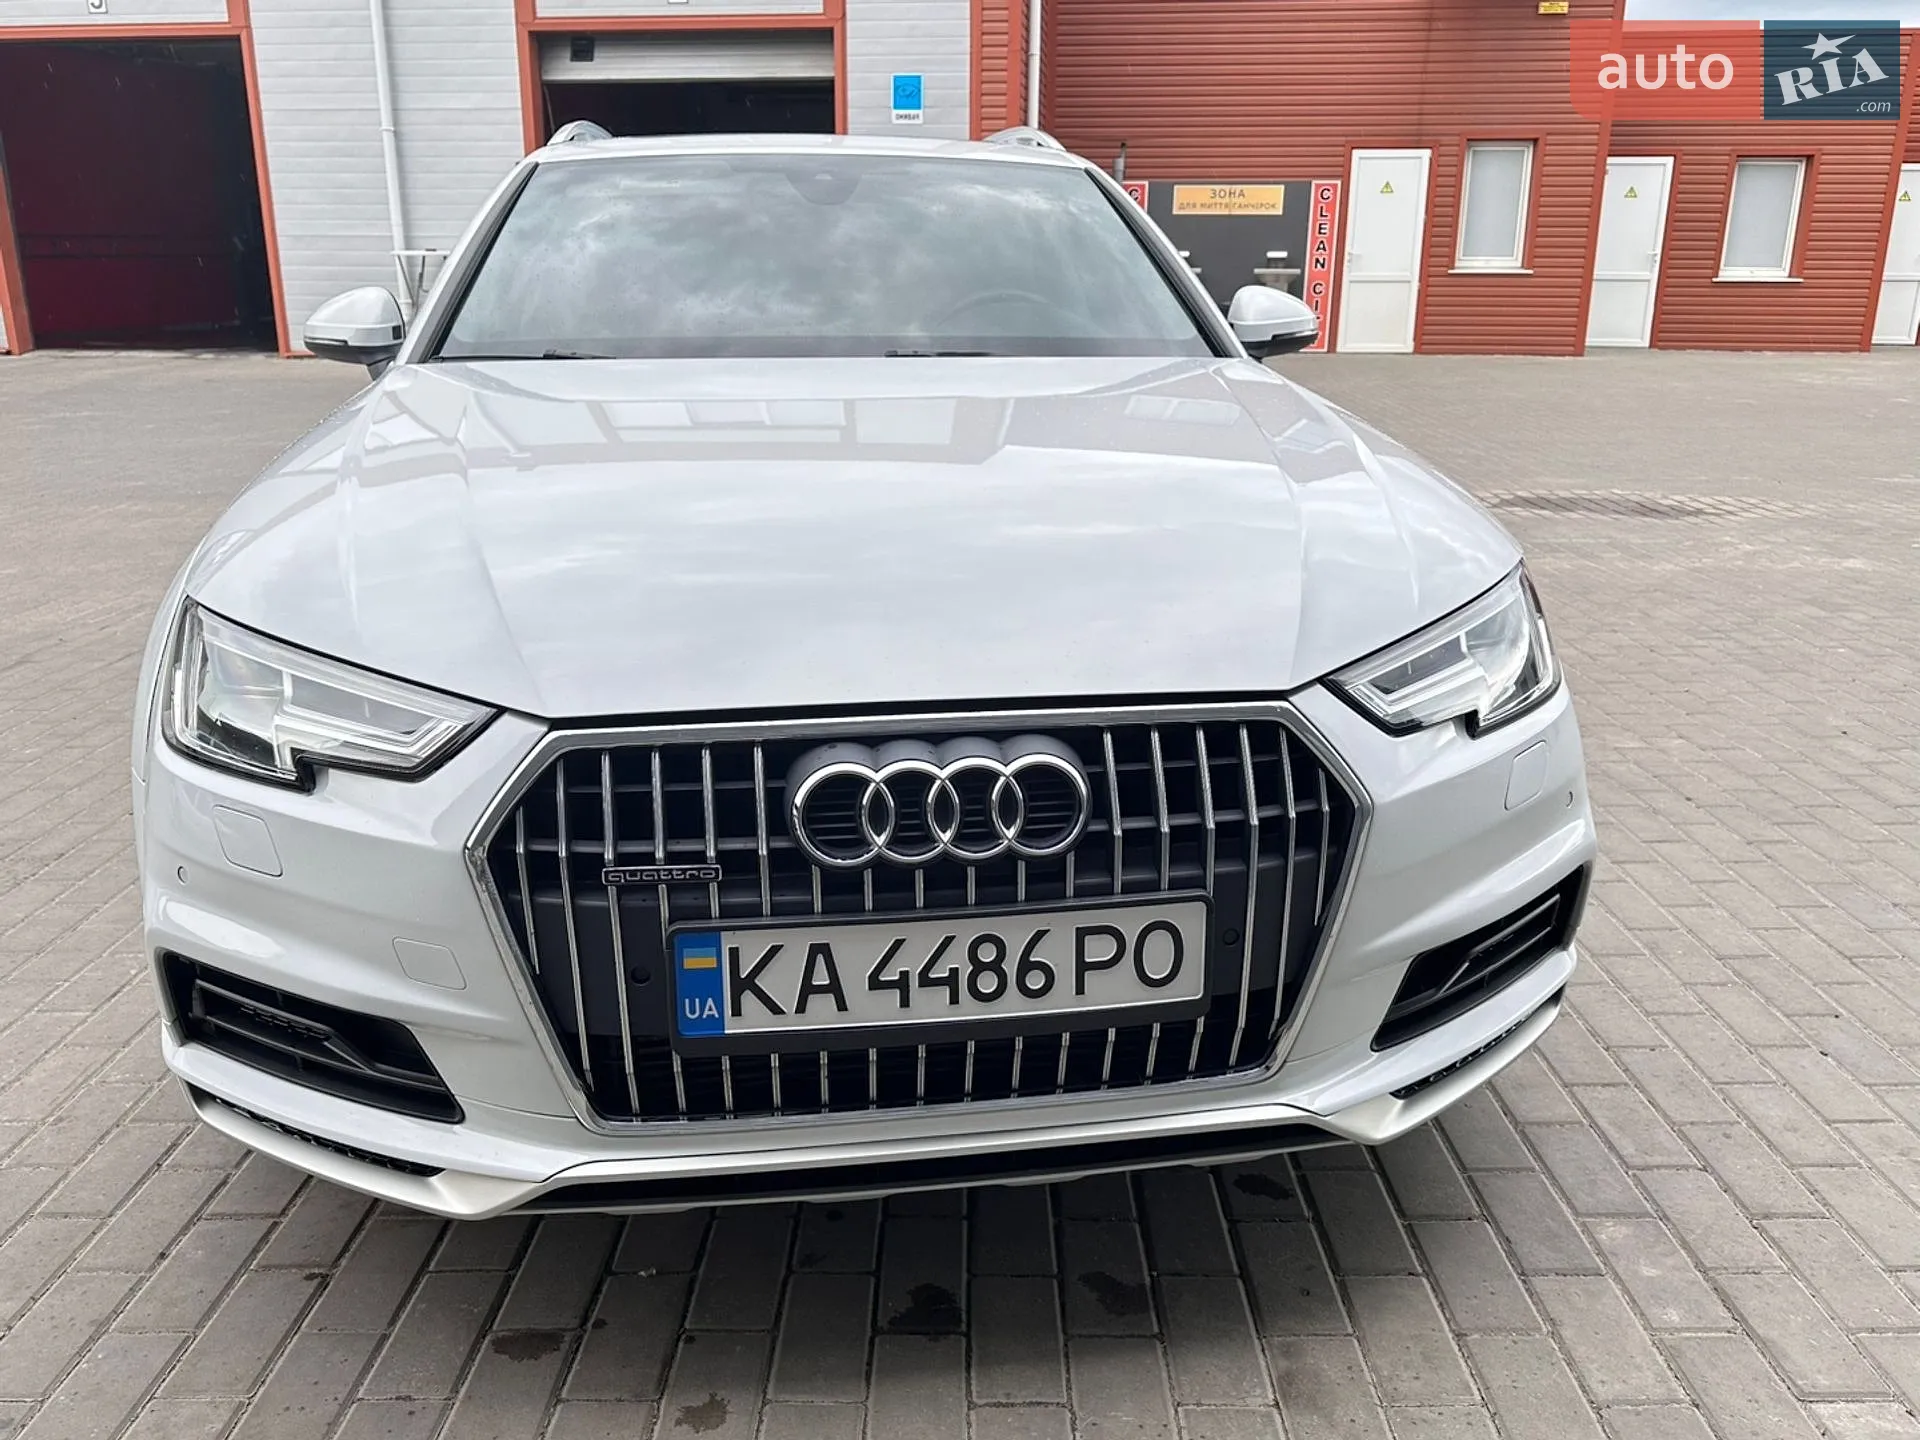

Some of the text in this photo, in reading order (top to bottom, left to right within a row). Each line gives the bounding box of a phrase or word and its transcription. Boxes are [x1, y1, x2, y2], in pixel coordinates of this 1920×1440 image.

[1209, 188, 1246, 199] ЗОНА
[1178, 202, 1197, 210] ДЛЯ
[1314, 188, 1331, 269] CLEAN
[607, 869, 716, 883] quattro
[727, 919, 1185, 1018] KA 4486 PO
[684, 996, 719, 1020] UA
